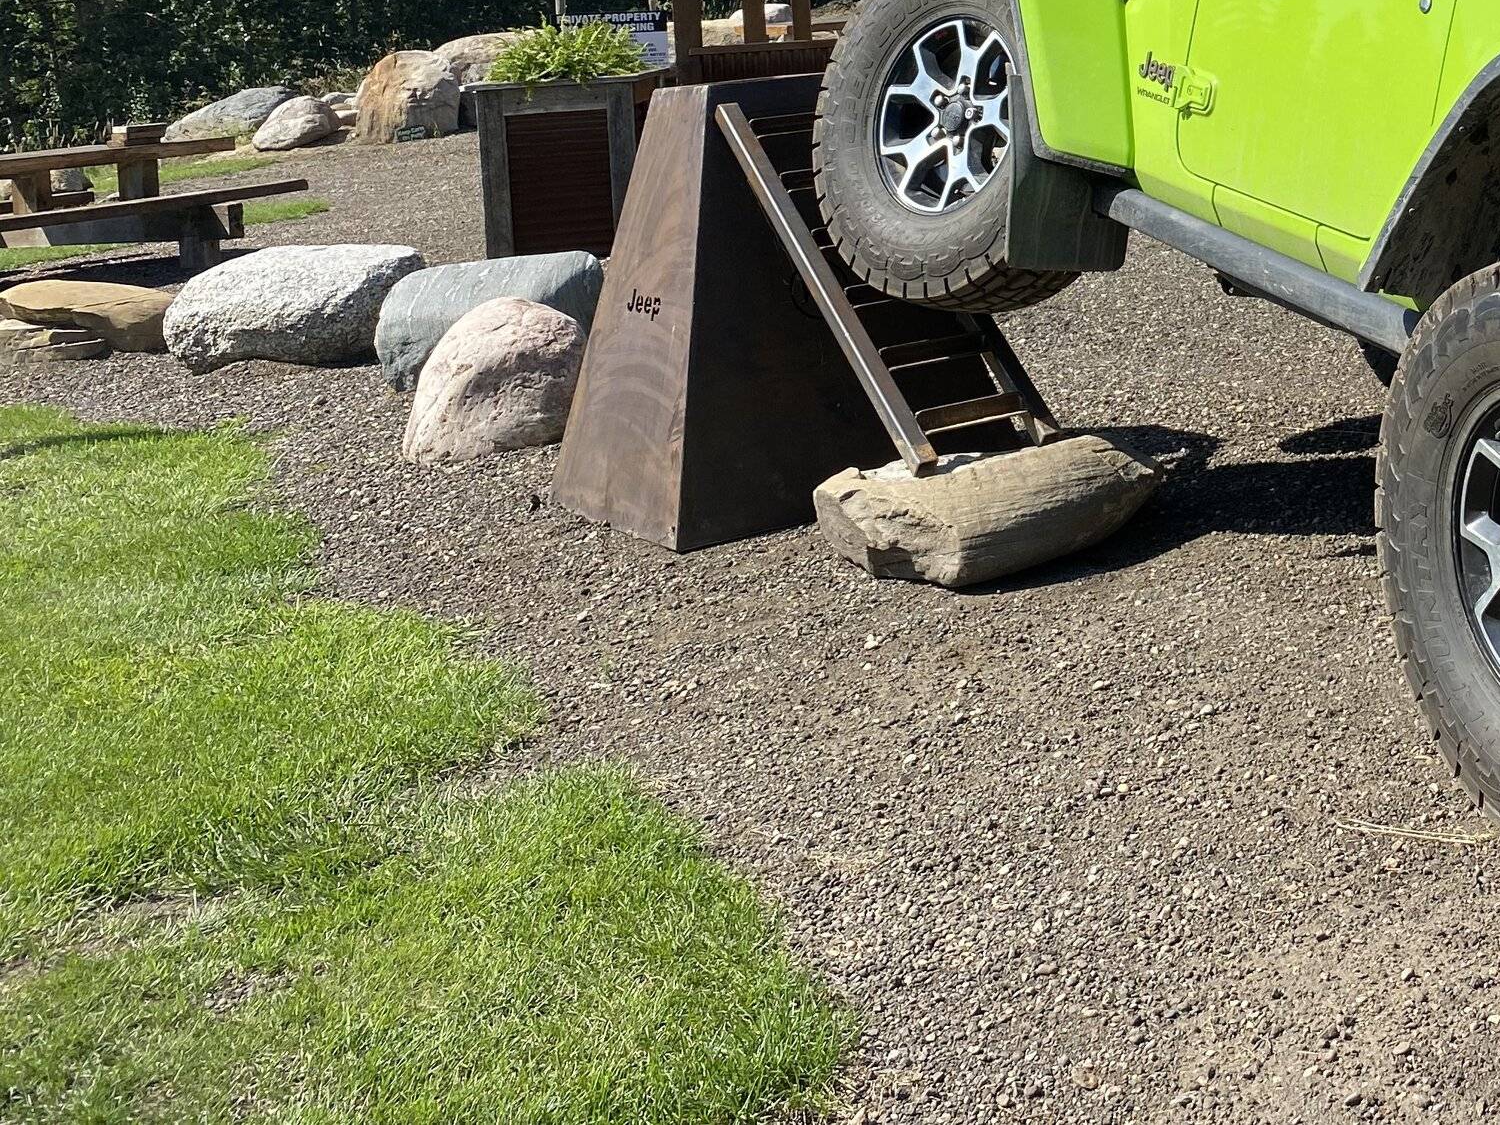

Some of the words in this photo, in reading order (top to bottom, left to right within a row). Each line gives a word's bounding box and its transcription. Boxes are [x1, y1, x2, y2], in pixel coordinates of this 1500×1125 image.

[604, 12, 661, 22] PROPERTY
[1138, 50, 1176, 93] Jeep
[627, 288, 661, 321] Jeep
